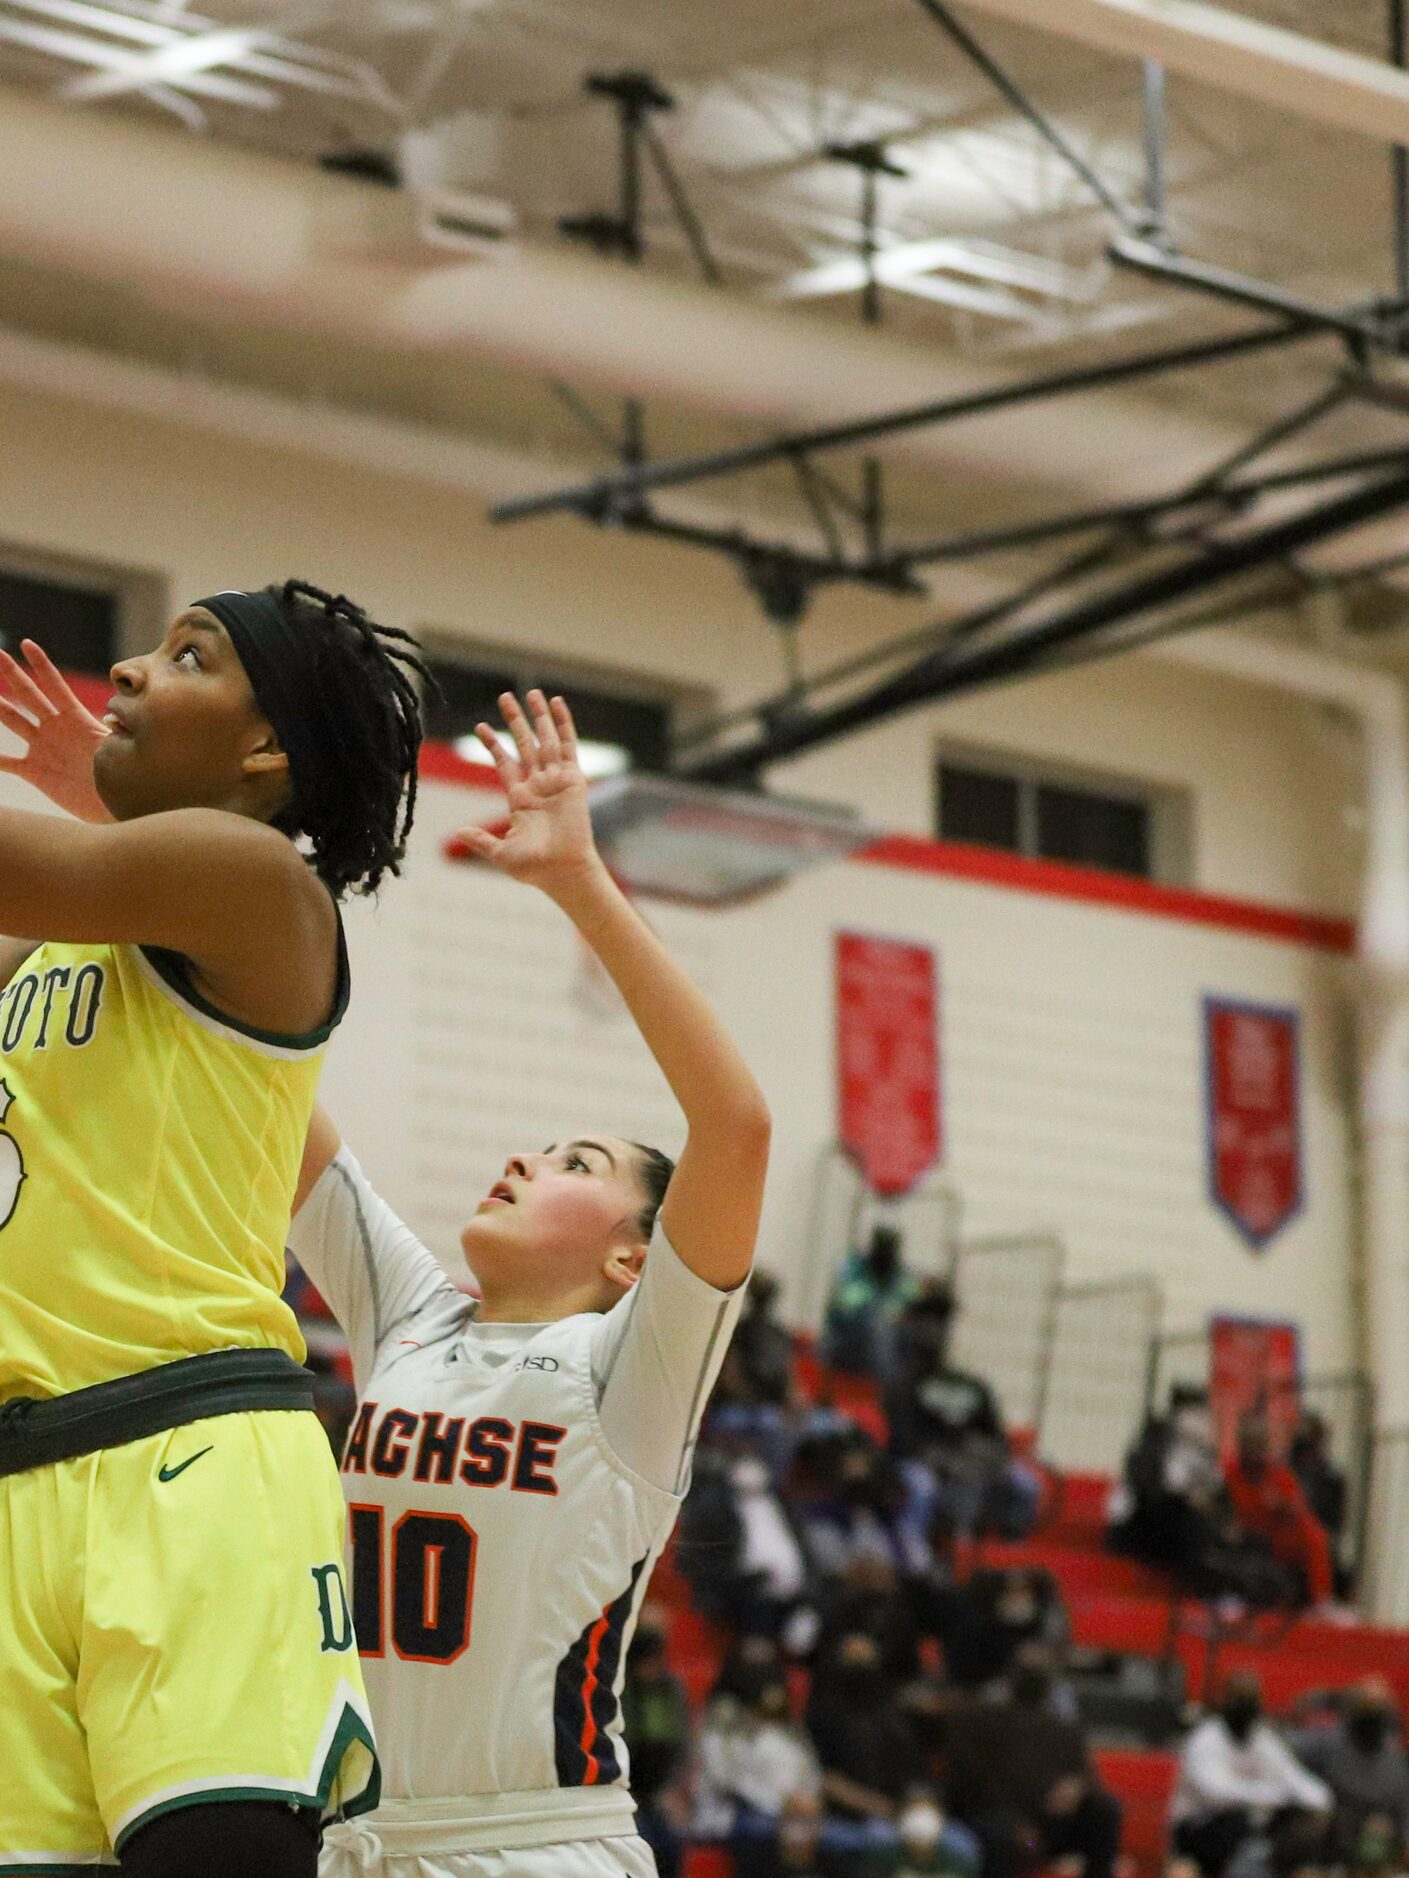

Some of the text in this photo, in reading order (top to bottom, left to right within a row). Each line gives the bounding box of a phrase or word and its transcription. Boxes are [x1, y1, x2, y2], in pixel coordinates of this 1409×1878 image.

[342, 1401, 568, 1497] ACHSE
[311, 1564, 353, 1652] D
[349, 1503, 478, 1666] 10
